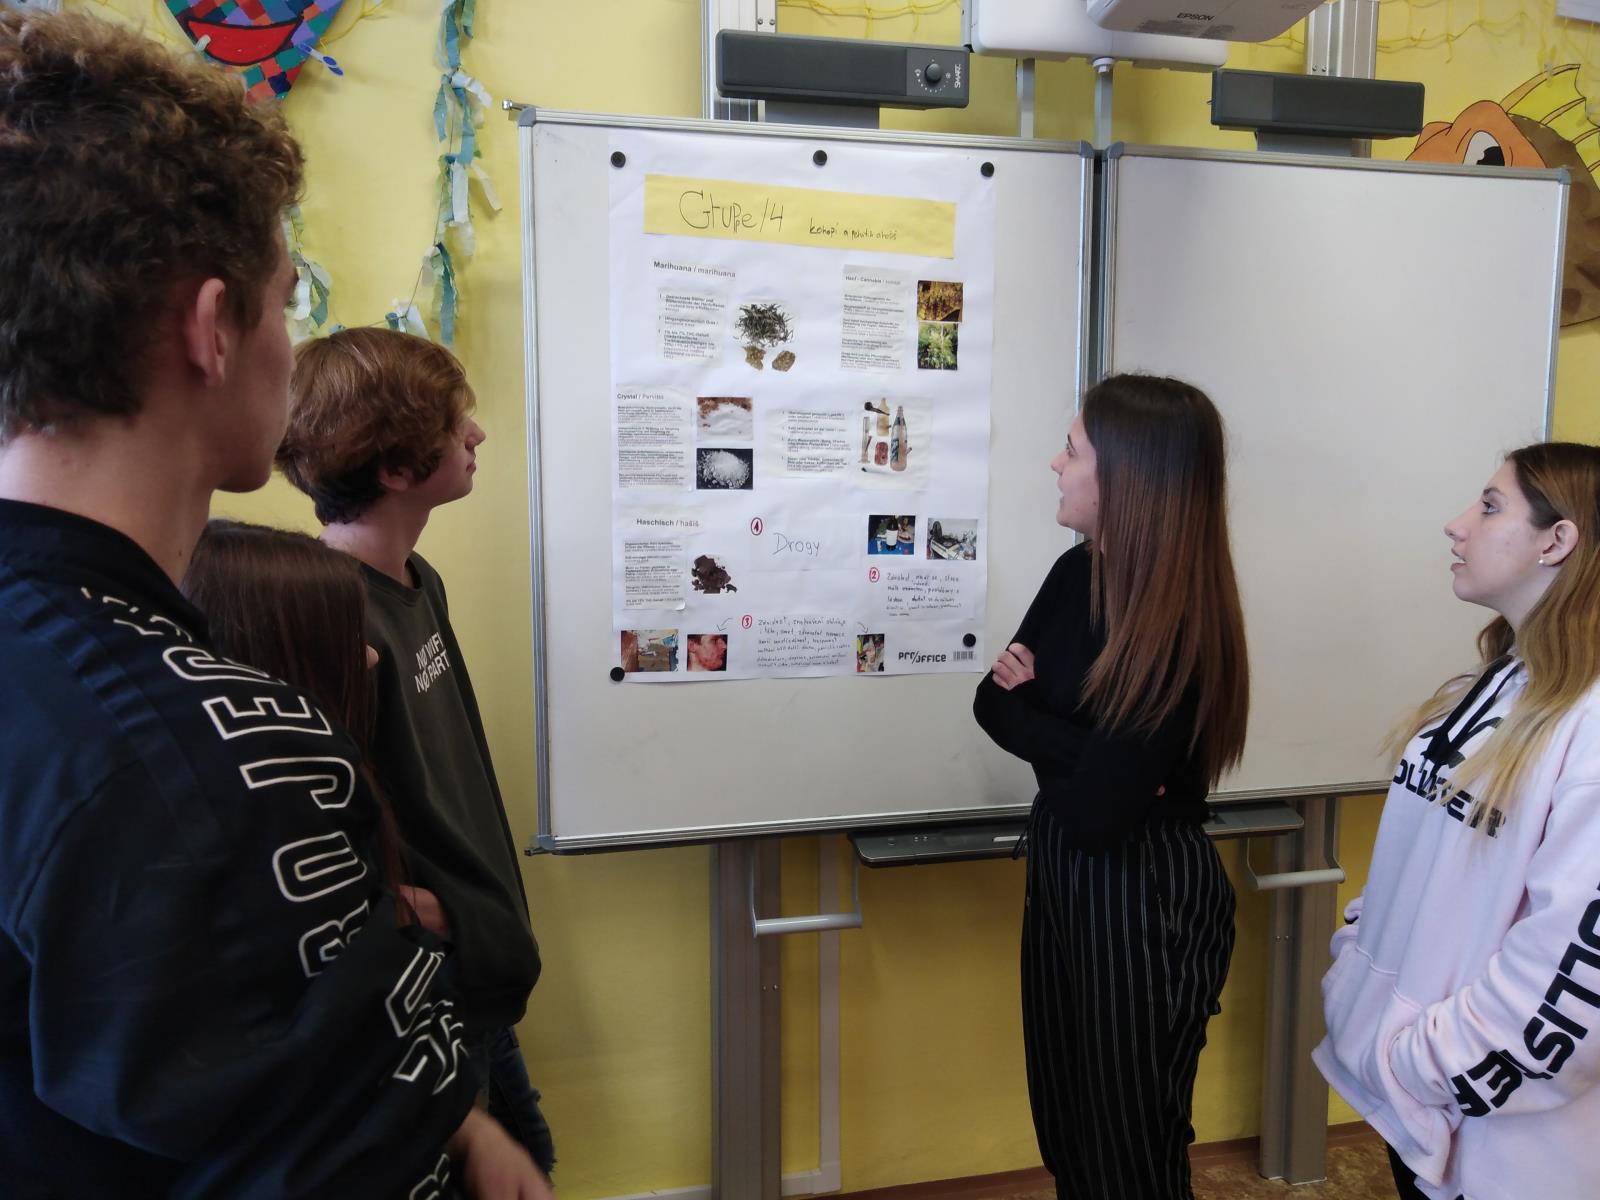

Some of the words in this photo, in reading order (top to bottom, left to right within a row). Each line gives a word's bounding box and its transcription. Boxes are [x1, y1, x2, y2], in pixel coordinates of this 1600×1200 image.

[1177, 12, 1215, 21] EPSON
[653, 261, 692, 273] Marihuana
[697, 267, 736, 278] marihuana
[636, 518, 675, 527] Haschisch
[772, 532, 821, 557] Drogy
